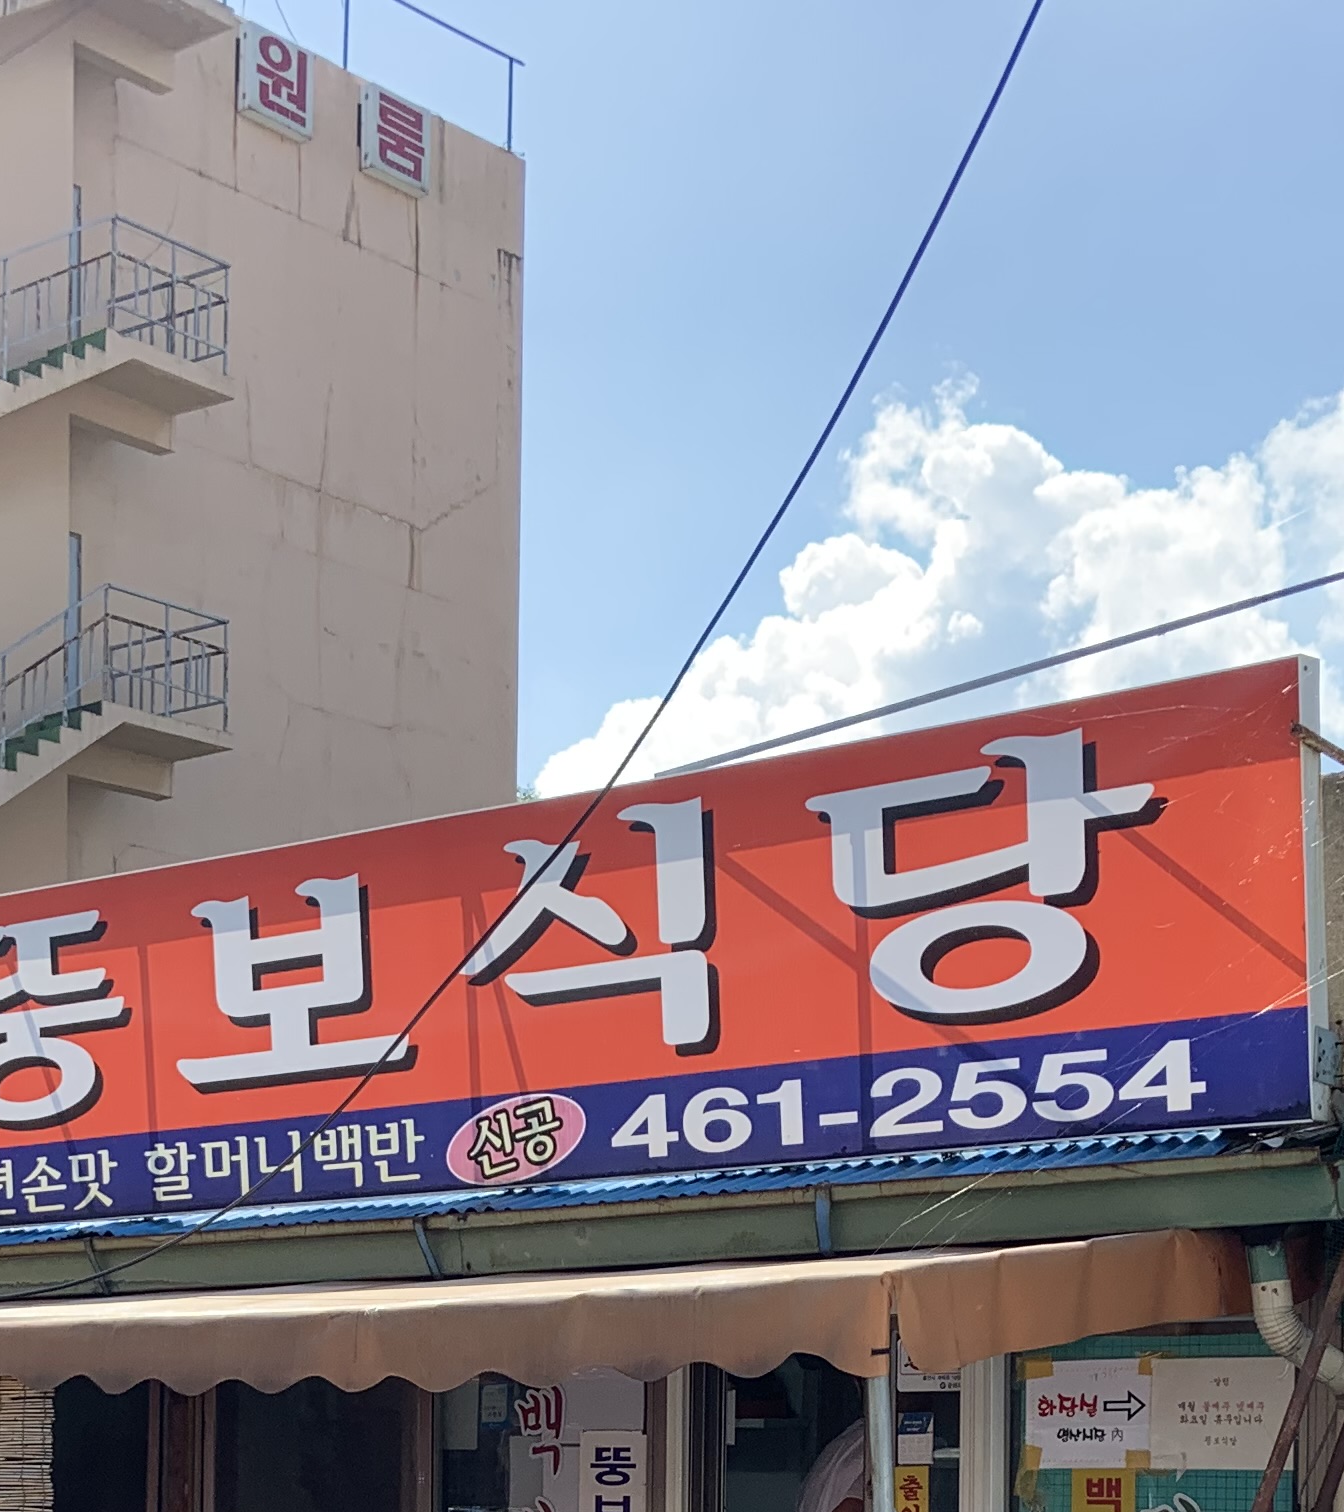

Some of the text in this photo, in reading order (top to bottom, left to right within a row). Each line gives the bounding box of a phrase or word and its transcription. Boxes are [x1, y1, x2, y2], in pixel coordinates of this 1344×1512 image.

[468, 1097, 563, 1180] 신공
[610, 1038, 1207, 1159] 461-2554
[144, 1118, 426, 1202] 할머니백반
[1037, 1393, 1098, 1418] 화장실
